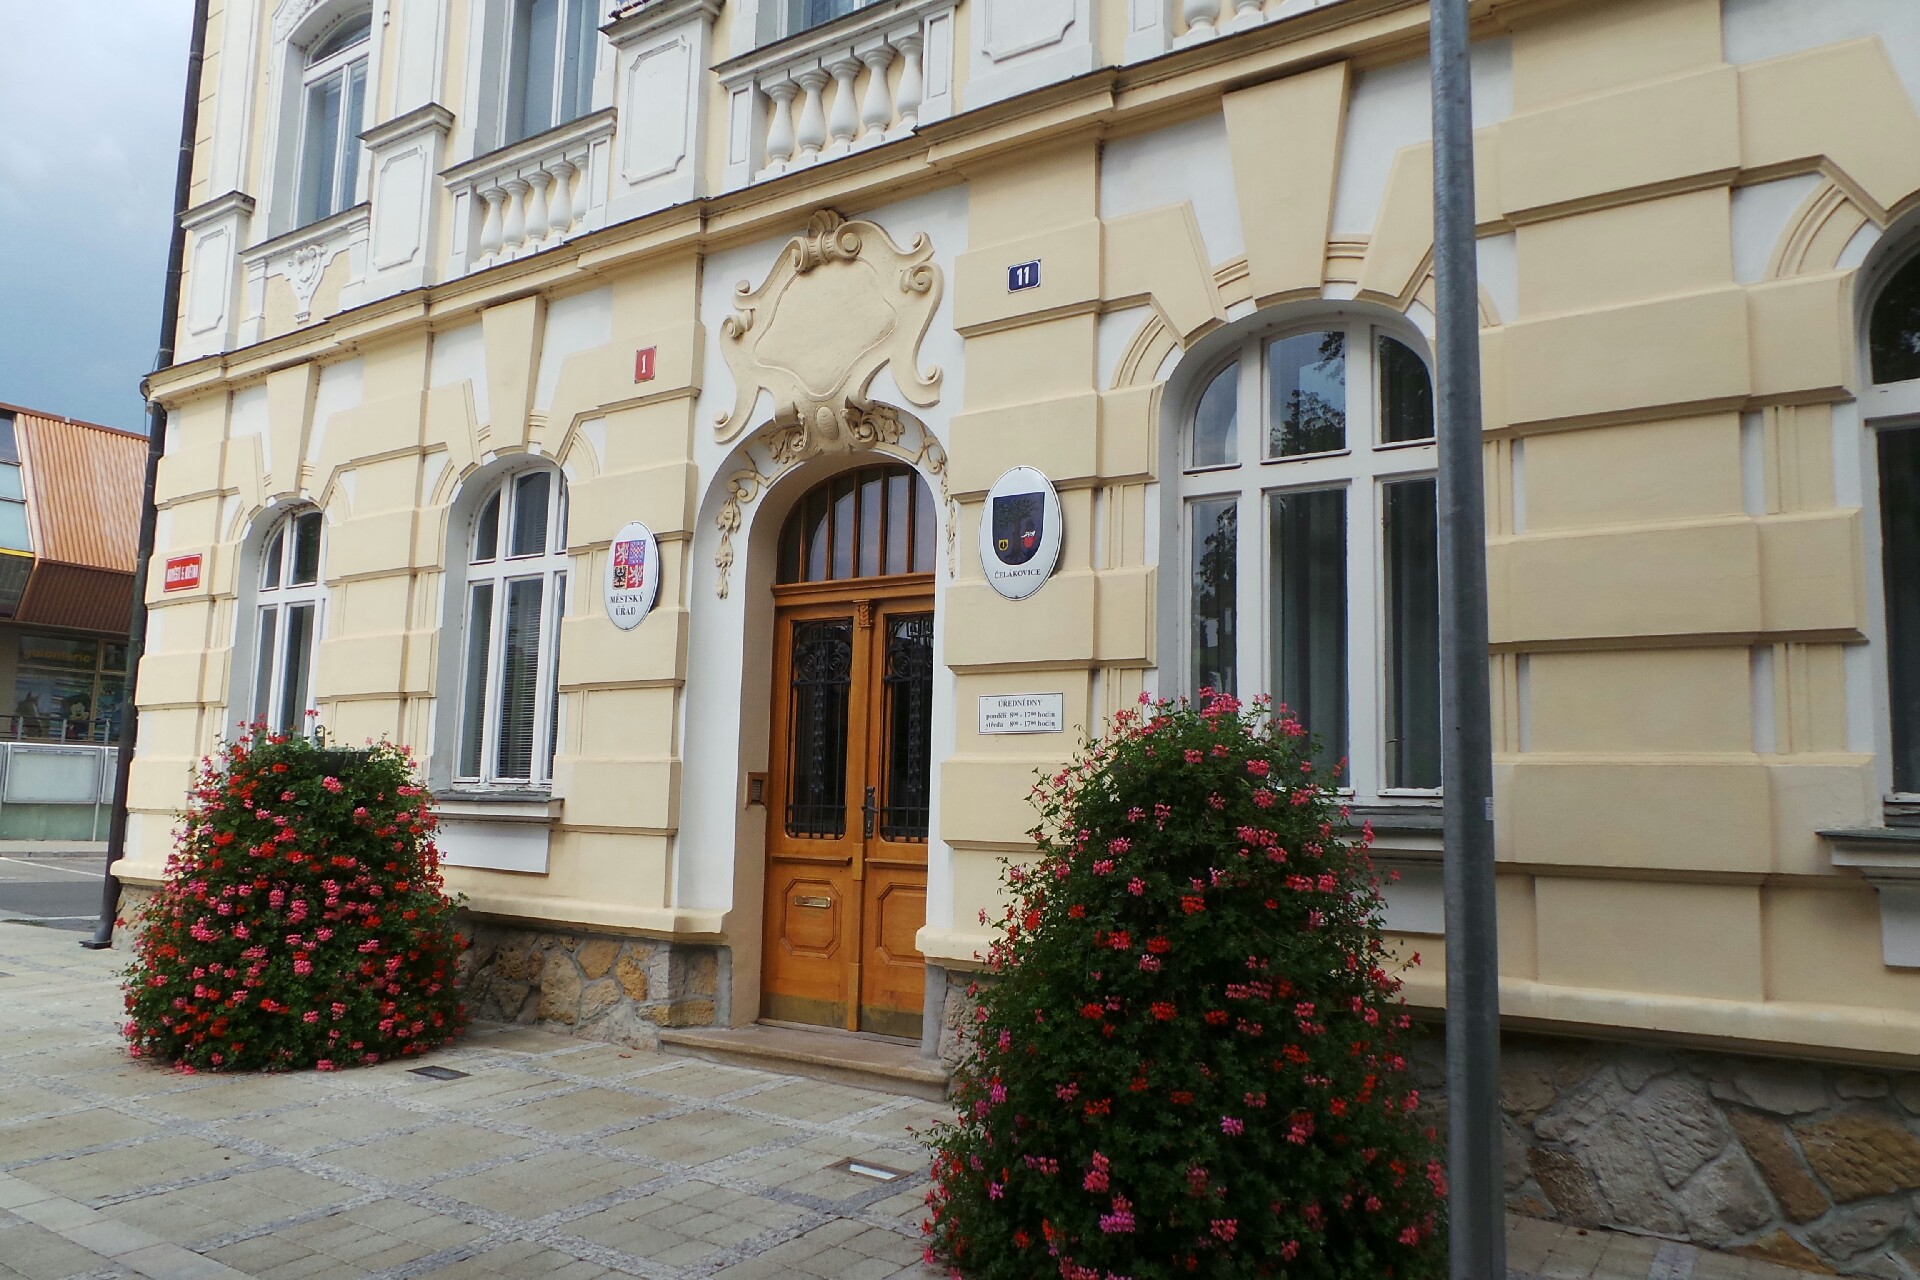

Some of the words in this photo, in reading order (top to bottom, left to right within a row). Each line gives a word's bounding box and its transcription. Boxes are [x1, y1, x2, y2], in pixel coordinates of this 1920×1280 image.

[1016, 266, 1030, 286] 11
[641, 354, 647, 374] 1
[994, 568, 1041, 579] ČELÁKOVICE
[610, 591, 644, 604] MĚSTSKÝ
[615, 605, 636, 616] ÚŘAD
[1037, 719, 1056, 727] hodin
